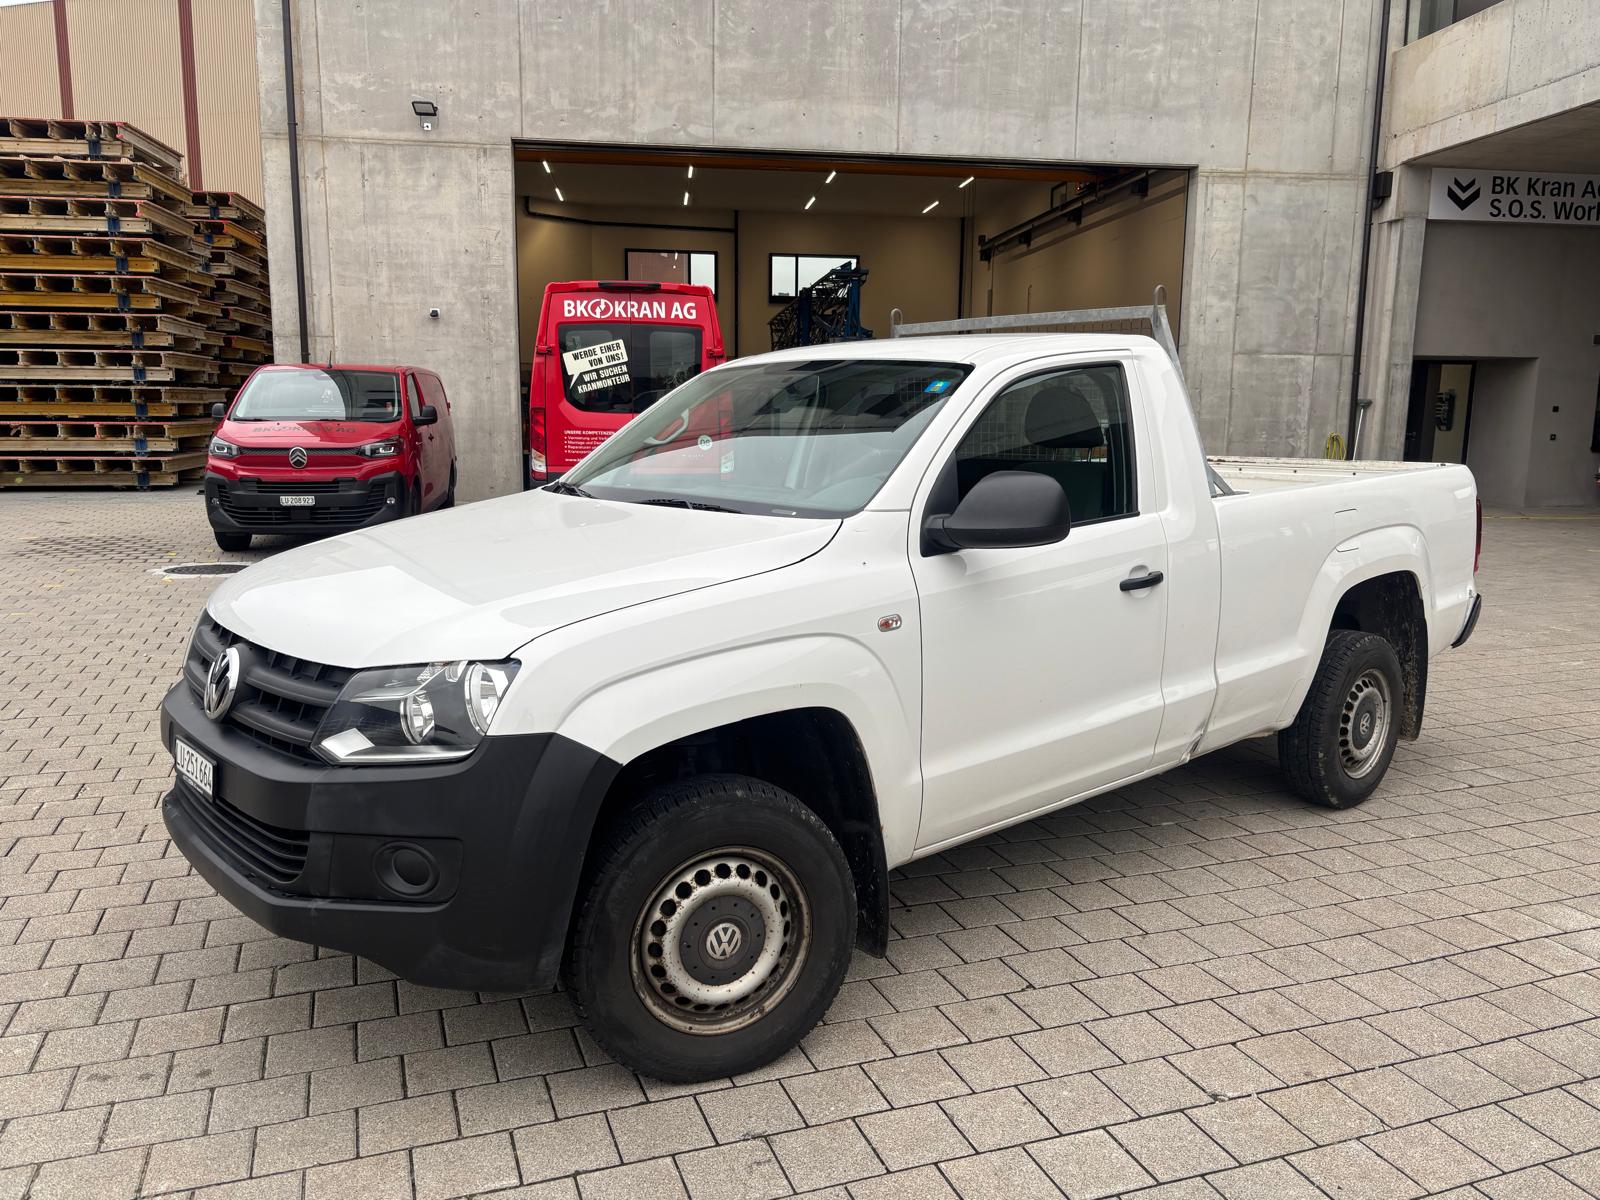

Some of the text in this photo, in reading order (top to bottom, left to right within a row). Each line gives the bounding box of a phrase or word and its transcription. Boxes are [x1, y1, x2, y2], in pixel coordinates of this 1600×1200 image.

[1491, 176, 1520, 196] BK
[1527, 177, 1575, 198] Kran
[1489, 198, 1546, 219] S.O.S.
[564, 300, 697, 319] BK KRAN AG
[571, 342, 622, 361] WERDE EINER
[588, 351, 625, 367] VON UNS!
[582, 364, 628, 382] WIR SUCHEN
[577, 373, 631, 394] KRANMONTEUR
